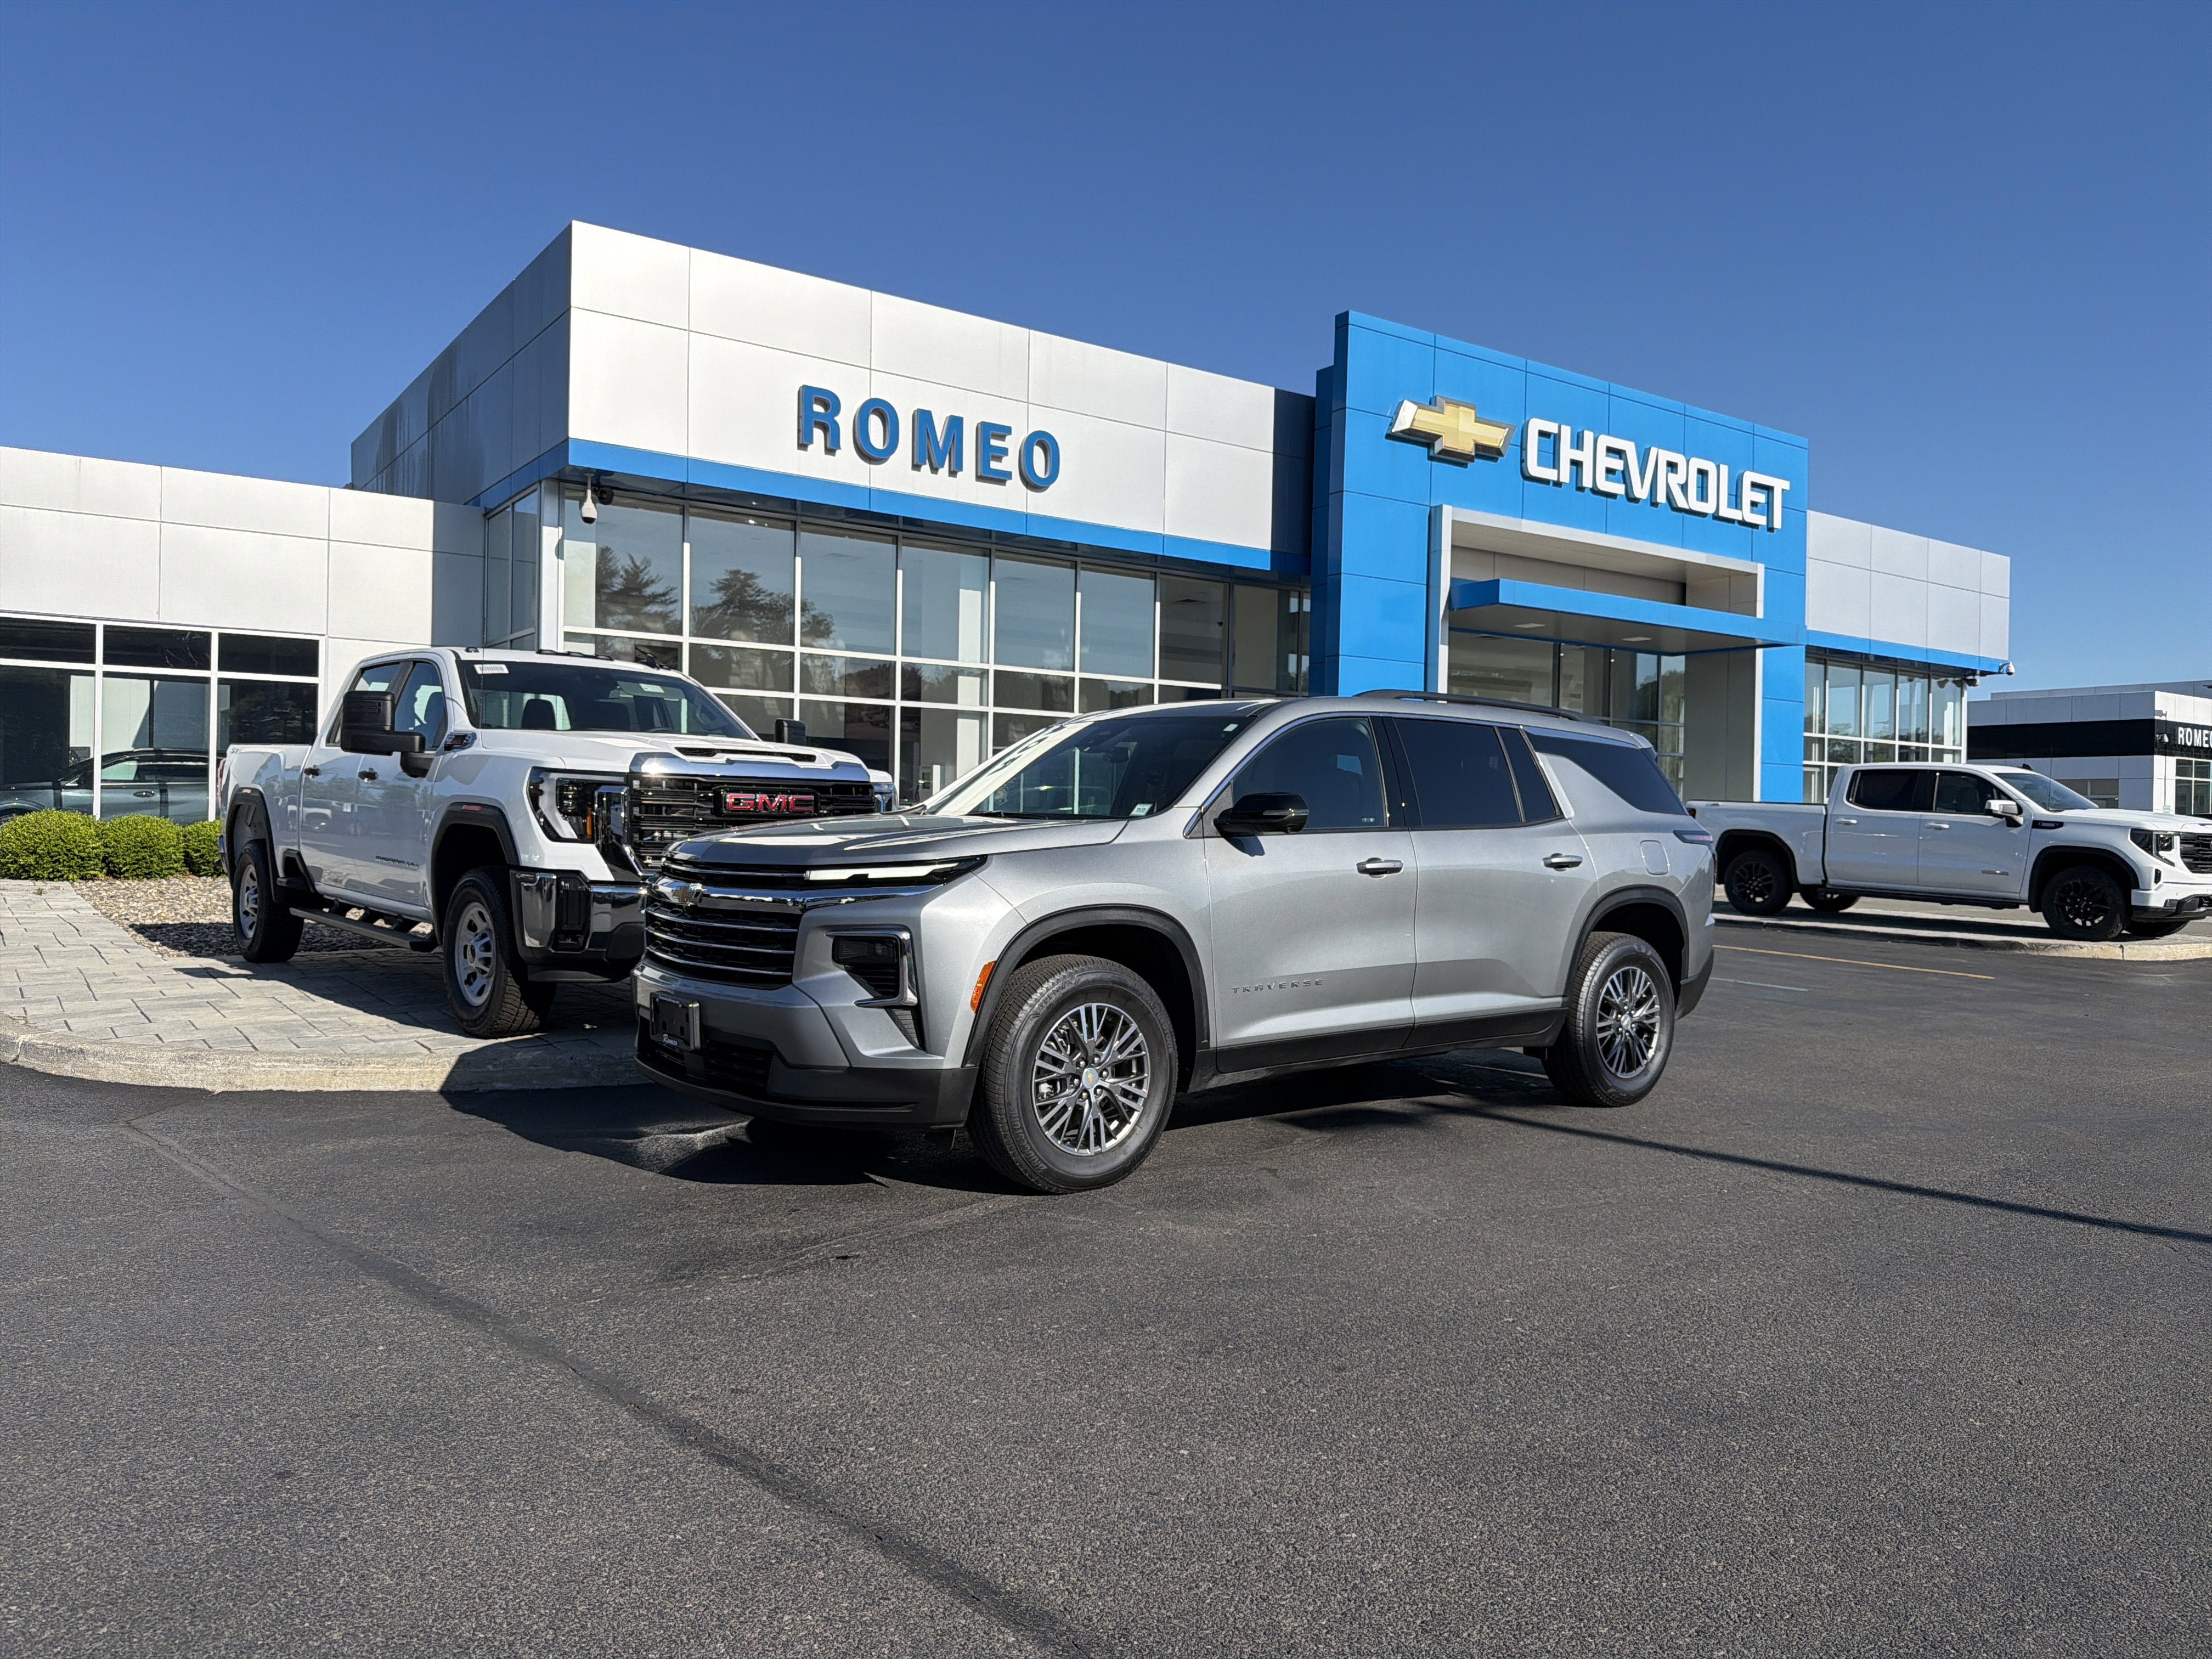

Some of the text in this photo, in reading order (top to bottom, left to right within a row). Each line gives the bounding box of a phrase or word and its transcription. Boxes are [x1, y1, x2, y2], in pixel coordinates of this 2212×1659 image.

[798, 385, 1060, 492] ROMEO
[1522, 417, 1790, 531] CHEVROLET
[727, 793, 815, 812] GMC
[1231, 979, 1323, 994] TRAVERSE
